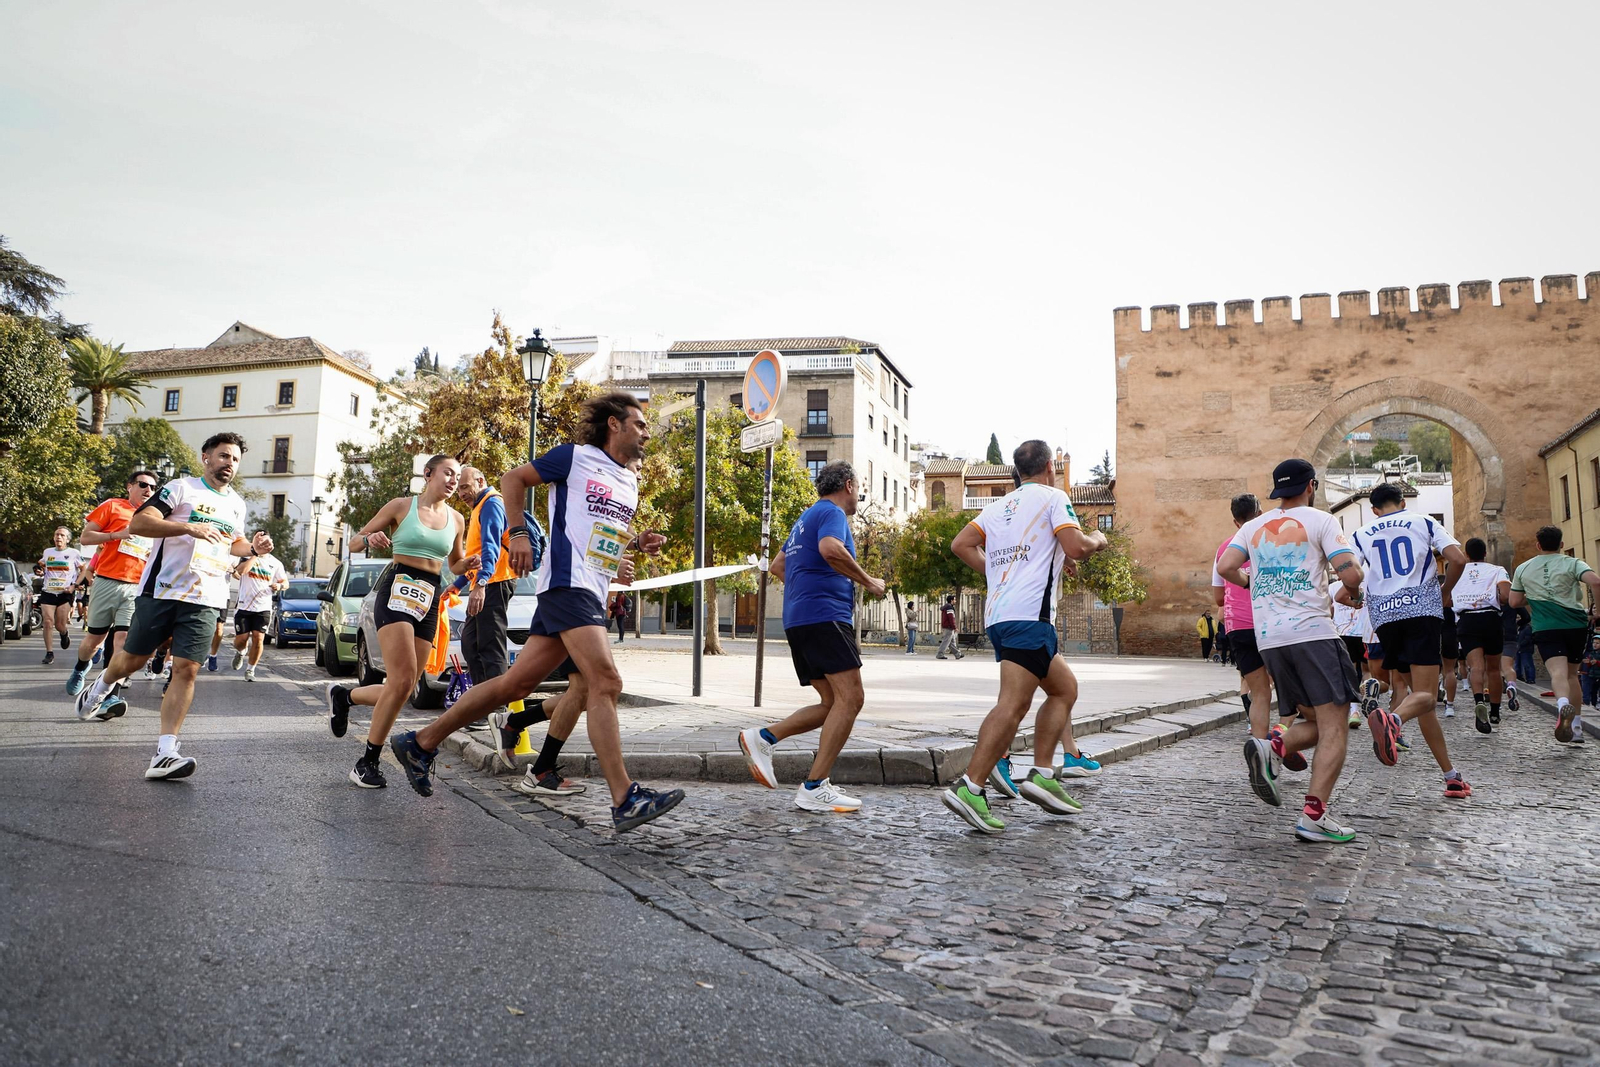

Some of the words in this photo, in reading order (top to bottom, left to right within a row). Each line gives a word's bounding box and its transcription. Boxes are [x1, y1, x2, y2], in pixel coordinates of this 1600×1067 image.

[588, 483, 612, 496] 10ª
[1365, 520, 1412, 536] LABELLA
[596, 538, 620, 556] 158
[989, 544, 1031, 560] UNIVERSIDAD
[1371, 535, 1415, 580] 10
[400, 586, 426, 603] 655
[1380, 594, 1419, 612] wiber
